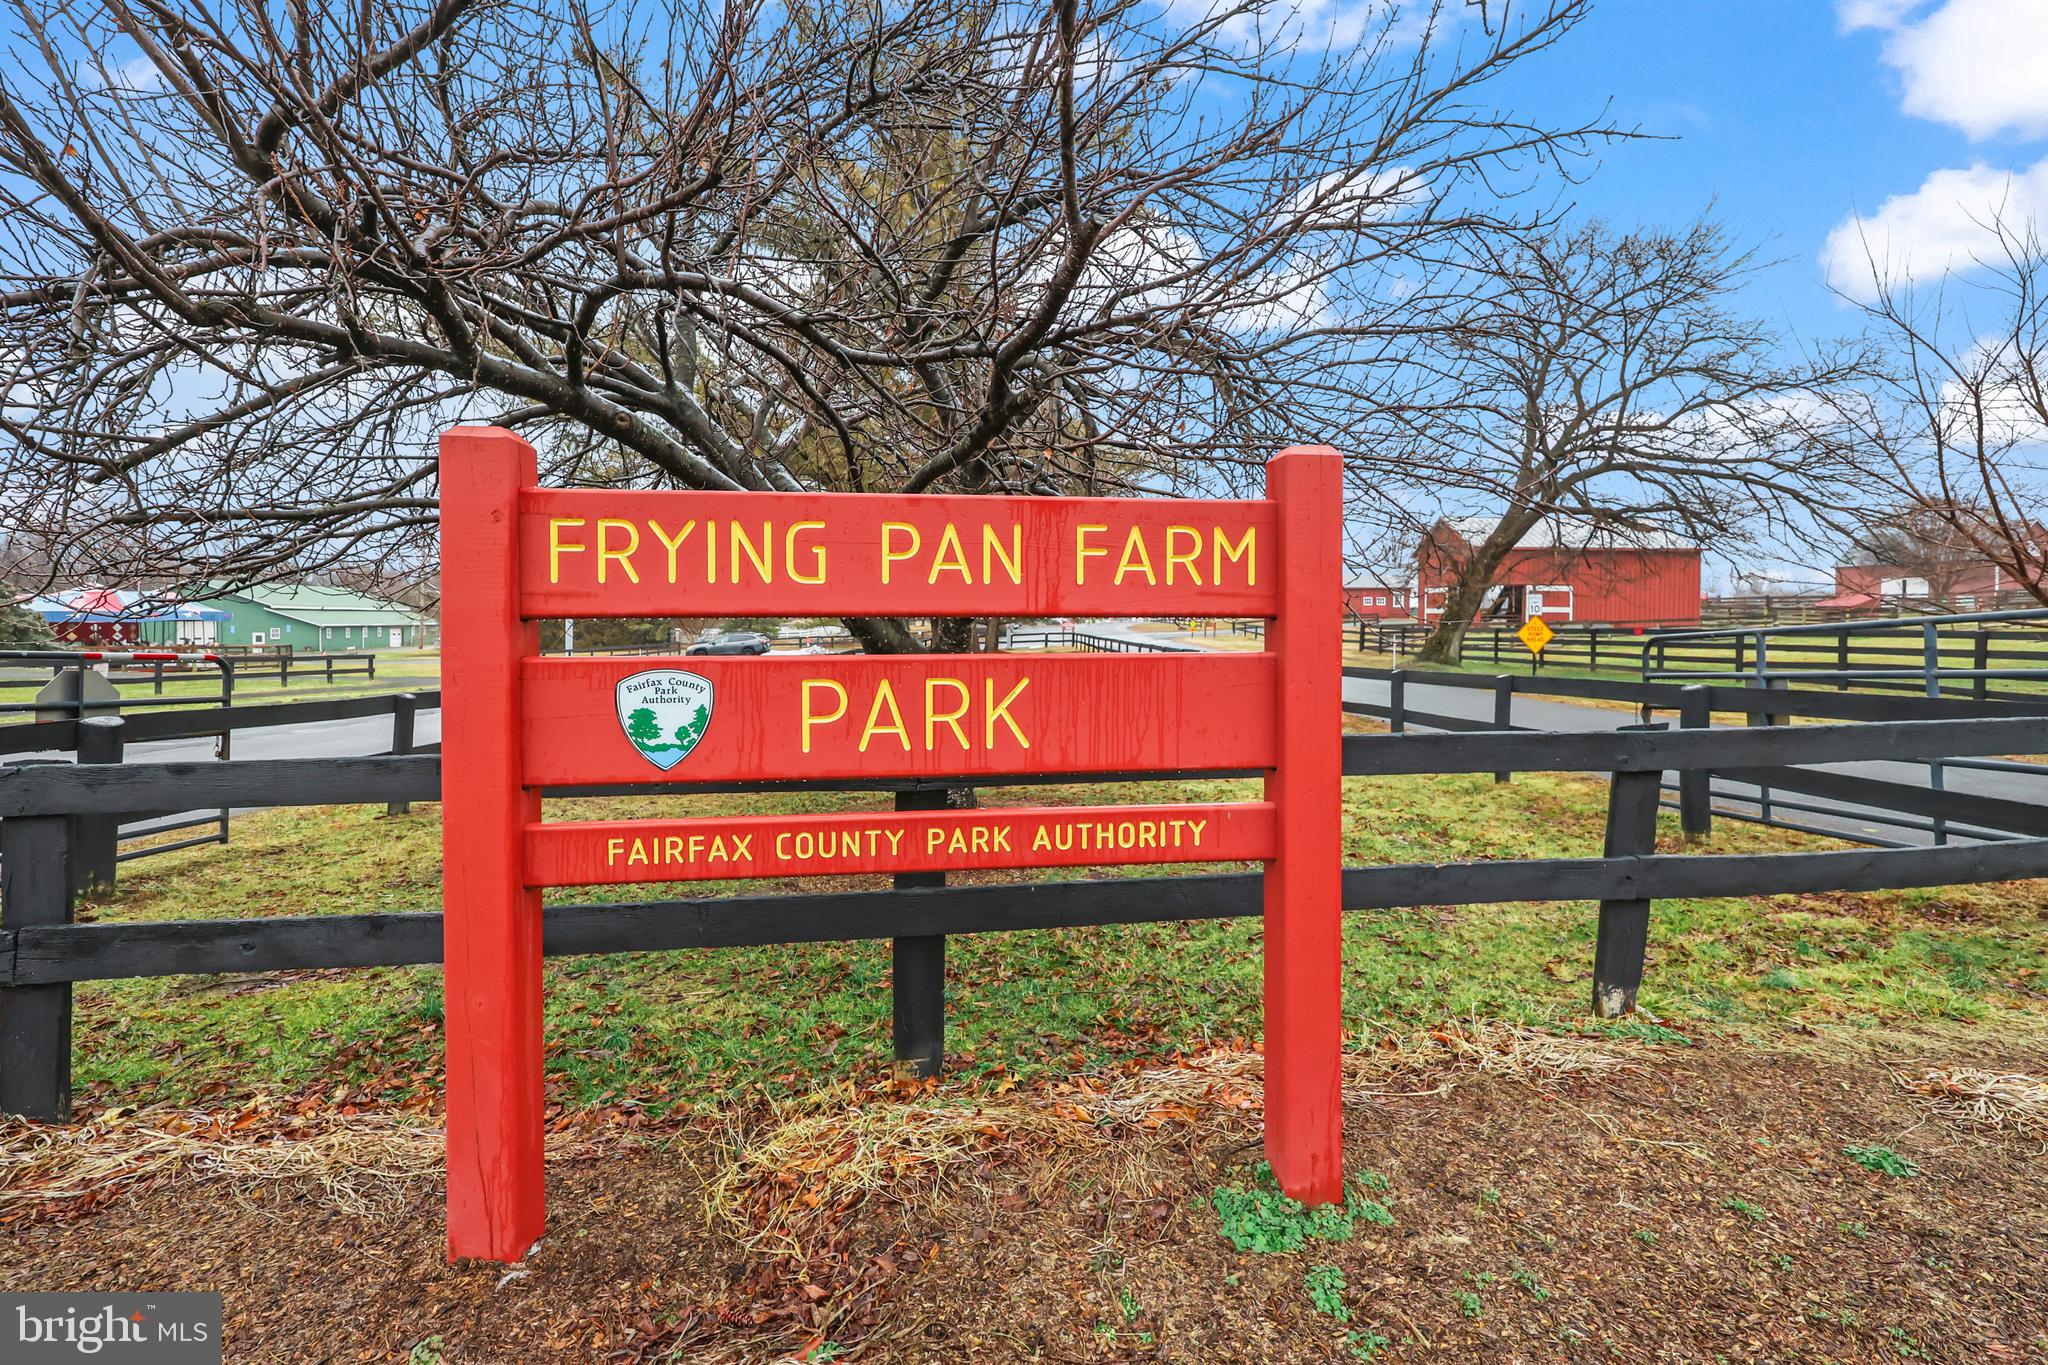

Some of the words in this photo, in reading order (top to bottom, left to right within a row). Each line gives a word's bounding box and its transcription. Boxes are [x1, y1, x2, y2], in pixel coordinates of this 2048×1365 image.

[549, 518, 827, 585] FRYING
[881, 521, 1022, 585] PAN
[1076, 524, 1256, 586] FARM
[1530, 604, 1541, 613] 10
[626, 678, 662, 694] Fairfax
[668, 677, 706, 694] County
[654, 686, 678, 695] Park
[641, 695, 691, 705] Authority
[801, 677, 1030, 753] PARK
[607, 834, 753, 866] FAIRFAX
[776, 829, 905, 860] COUNTY
[927, 826, 1011, 855] PARK
[1032, 820, 1207, 851] AUTHORITY
